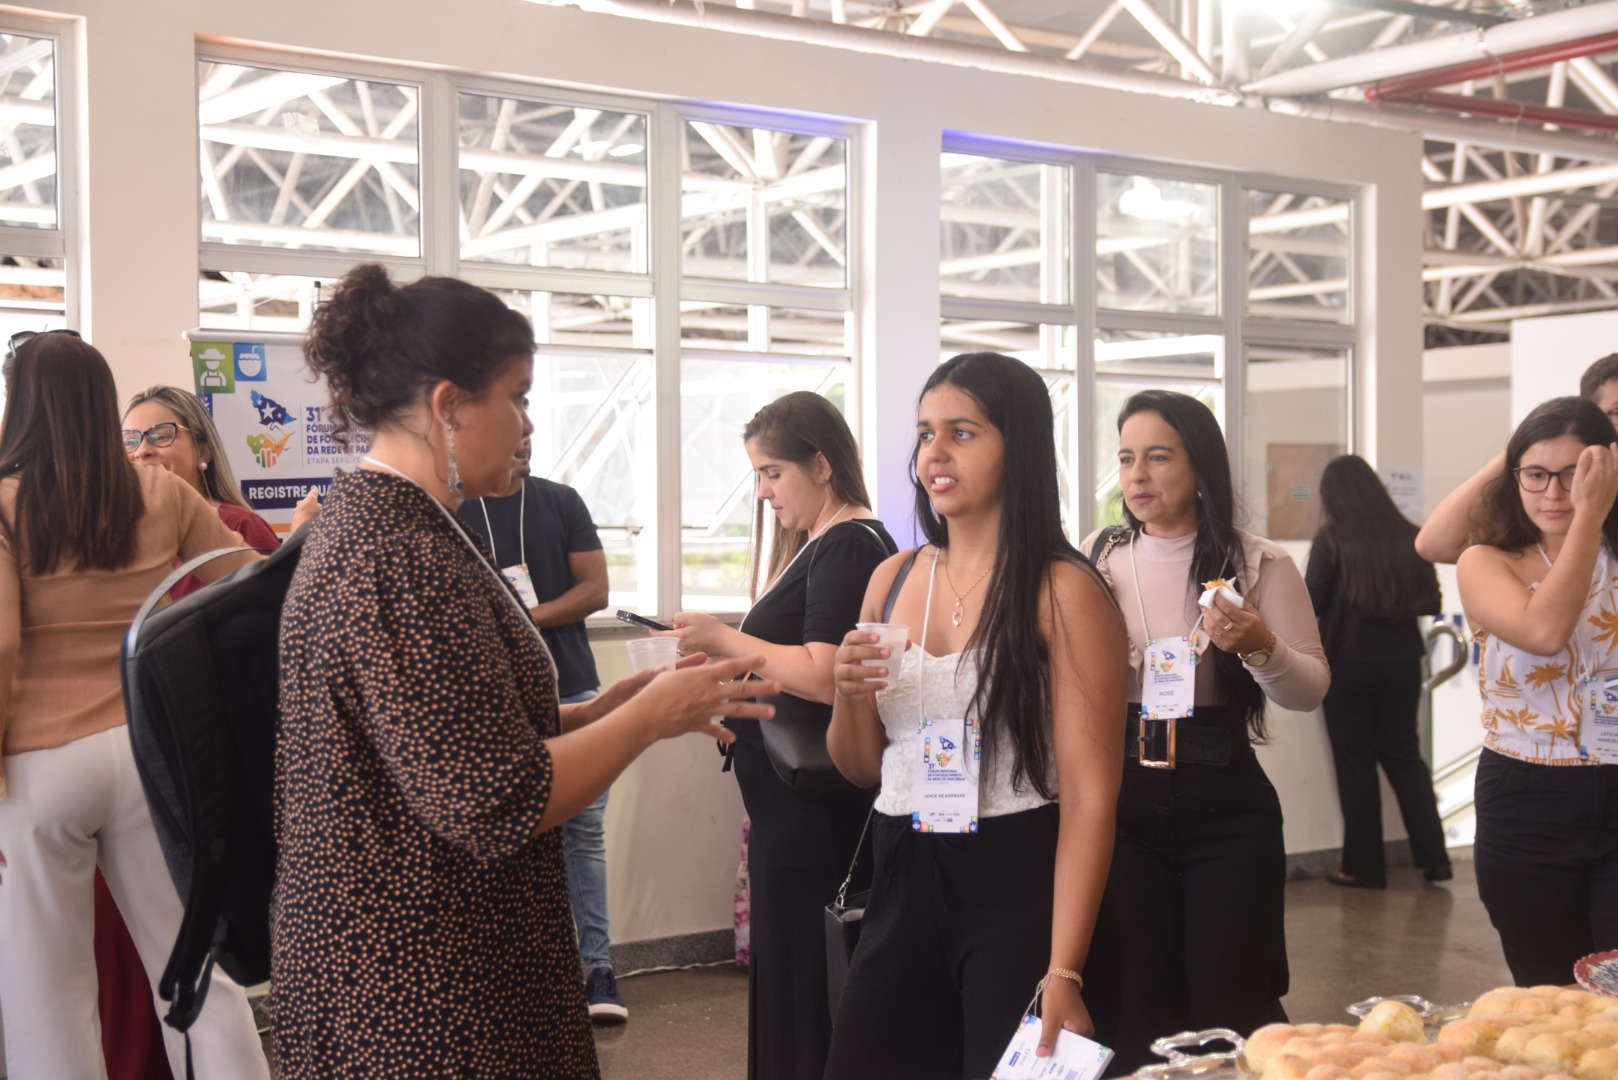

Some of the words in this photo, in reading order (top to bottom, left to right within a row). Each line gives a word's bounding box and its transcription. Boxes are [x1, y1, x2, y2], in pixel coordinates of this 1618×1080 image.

[306, 406, 326, 422] 31°
[307, 435, 318, 444] DE
[307, 446, 319, 454] DA
[321, 446, 342, 454] REDE
[249, 485, 307, 499] REGISTRE
